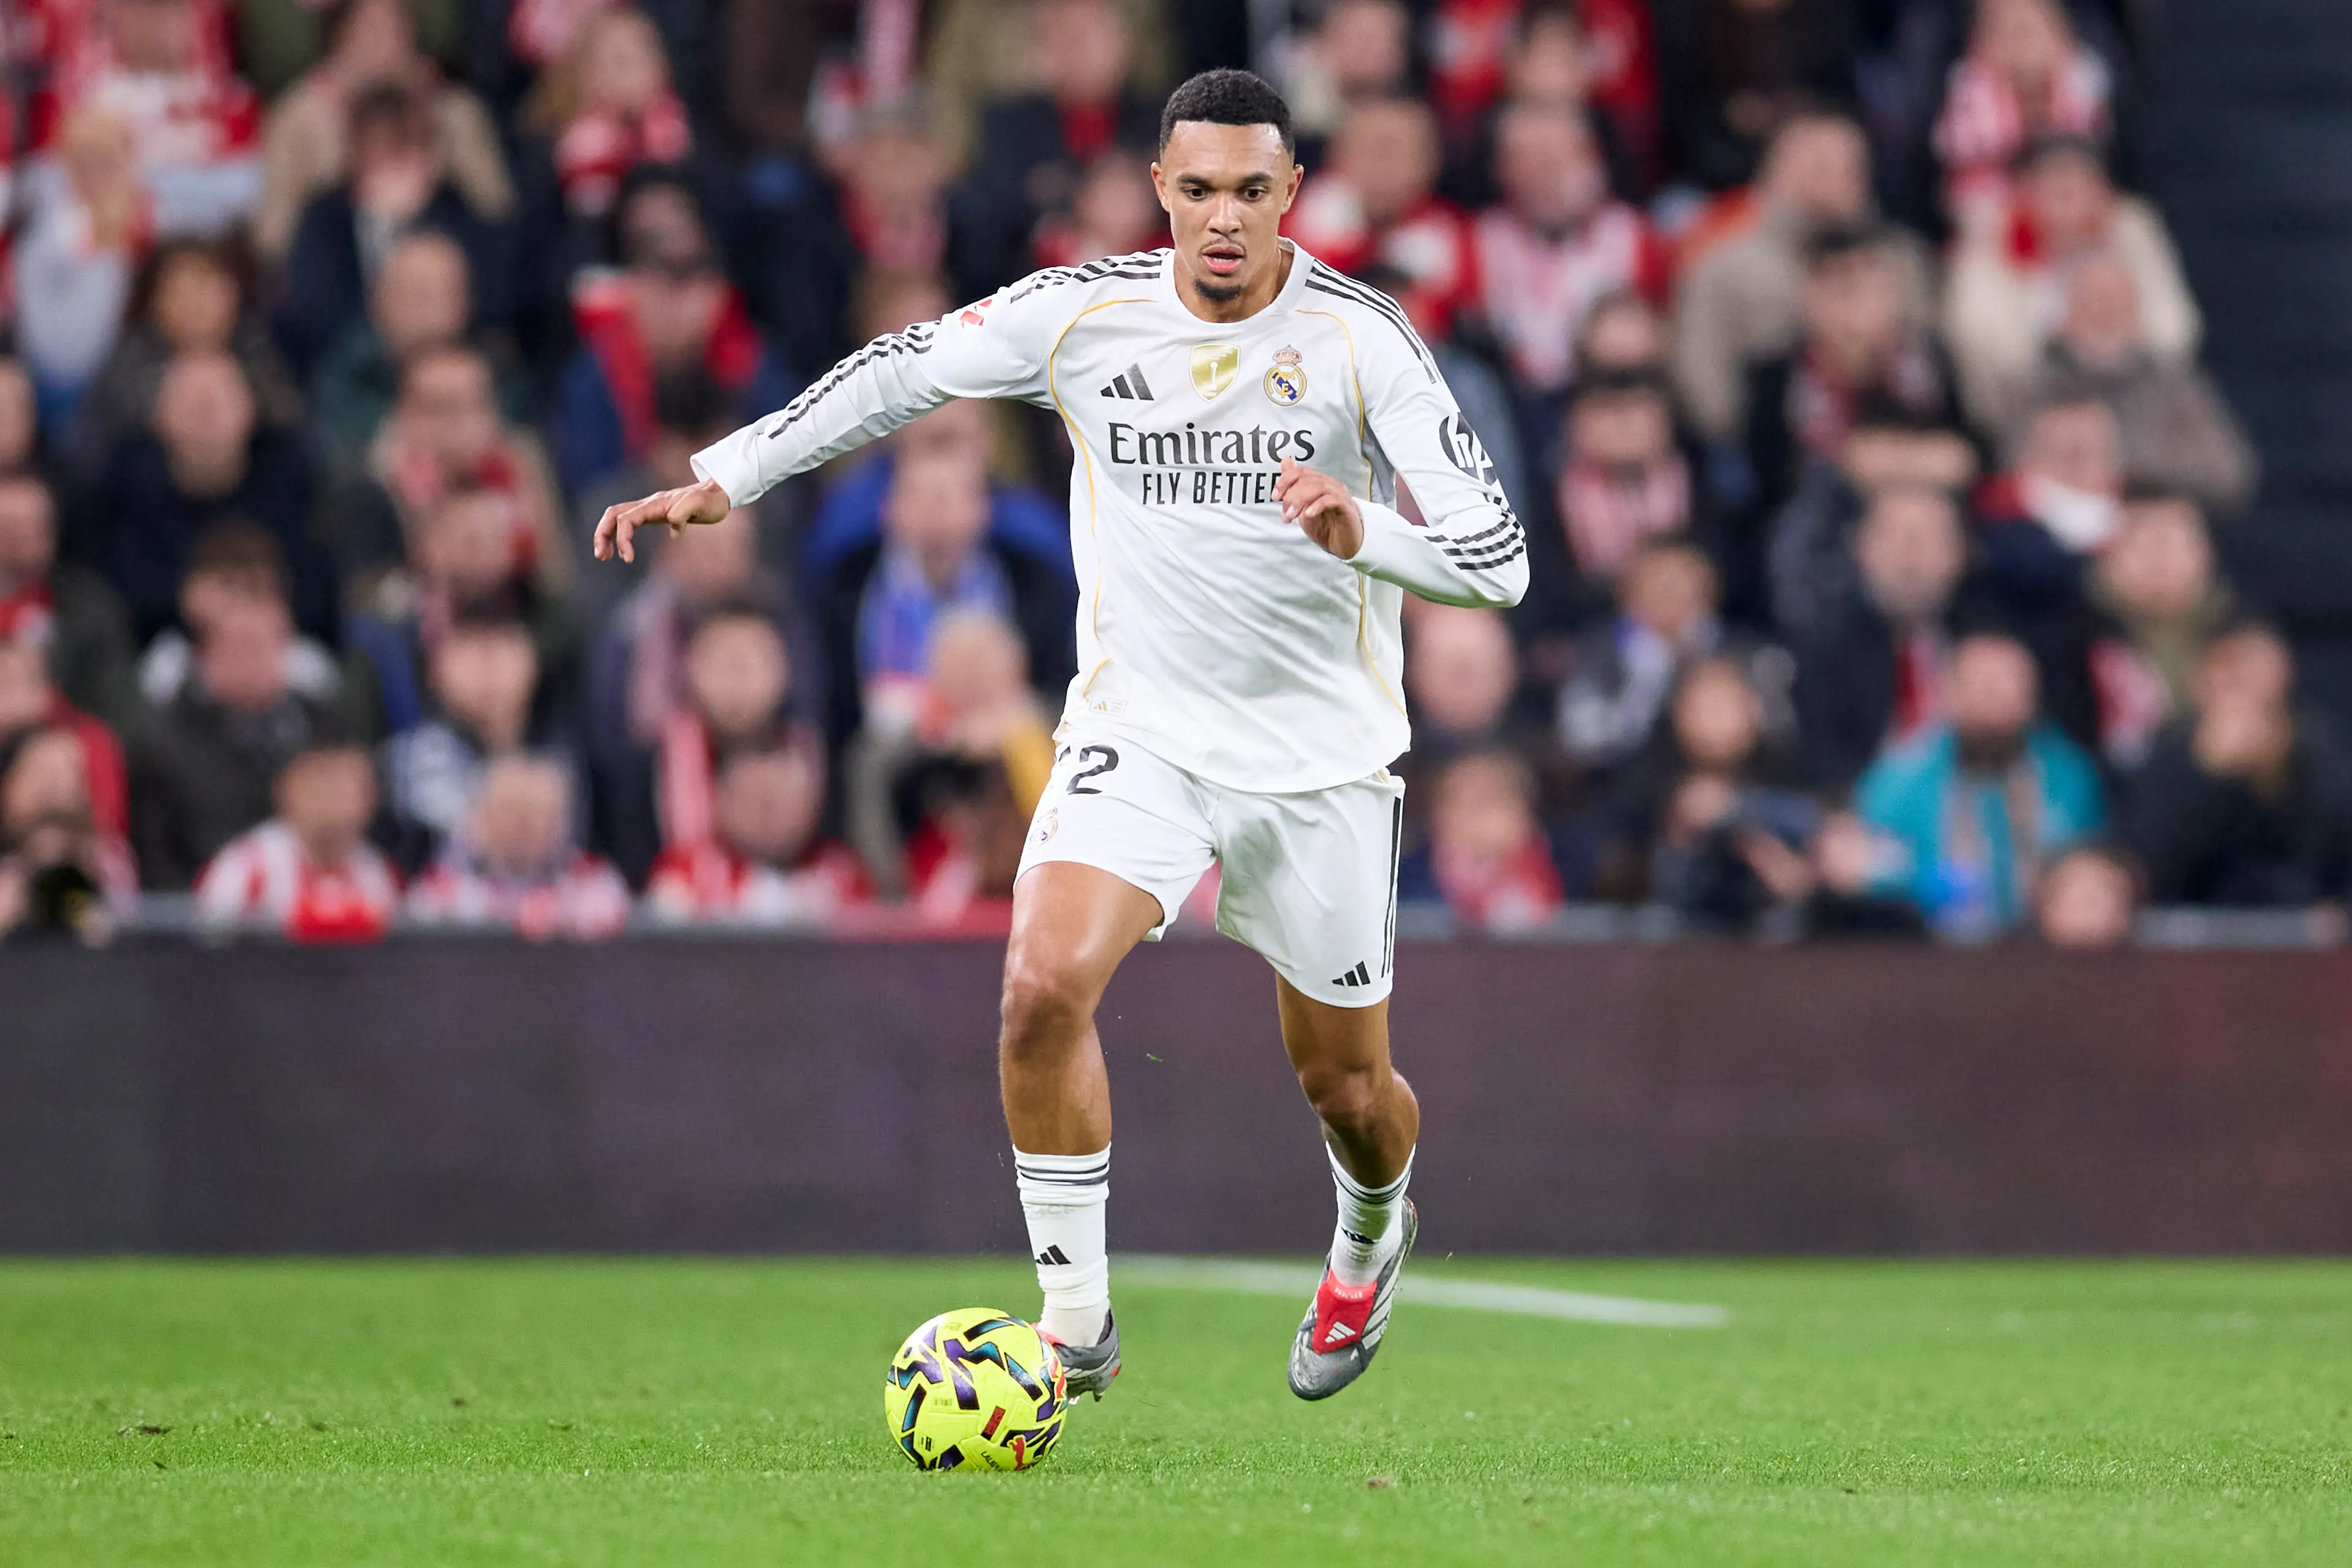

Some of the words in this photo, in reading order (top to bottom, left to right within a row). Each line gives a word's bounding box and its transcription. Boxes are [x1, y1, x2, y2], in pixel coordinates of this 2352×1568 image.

[1108, 422, 1315, 465] Emirates
[1142, 472, 1181, 505] FLY
[1058, 744, 1119, 795] 2
